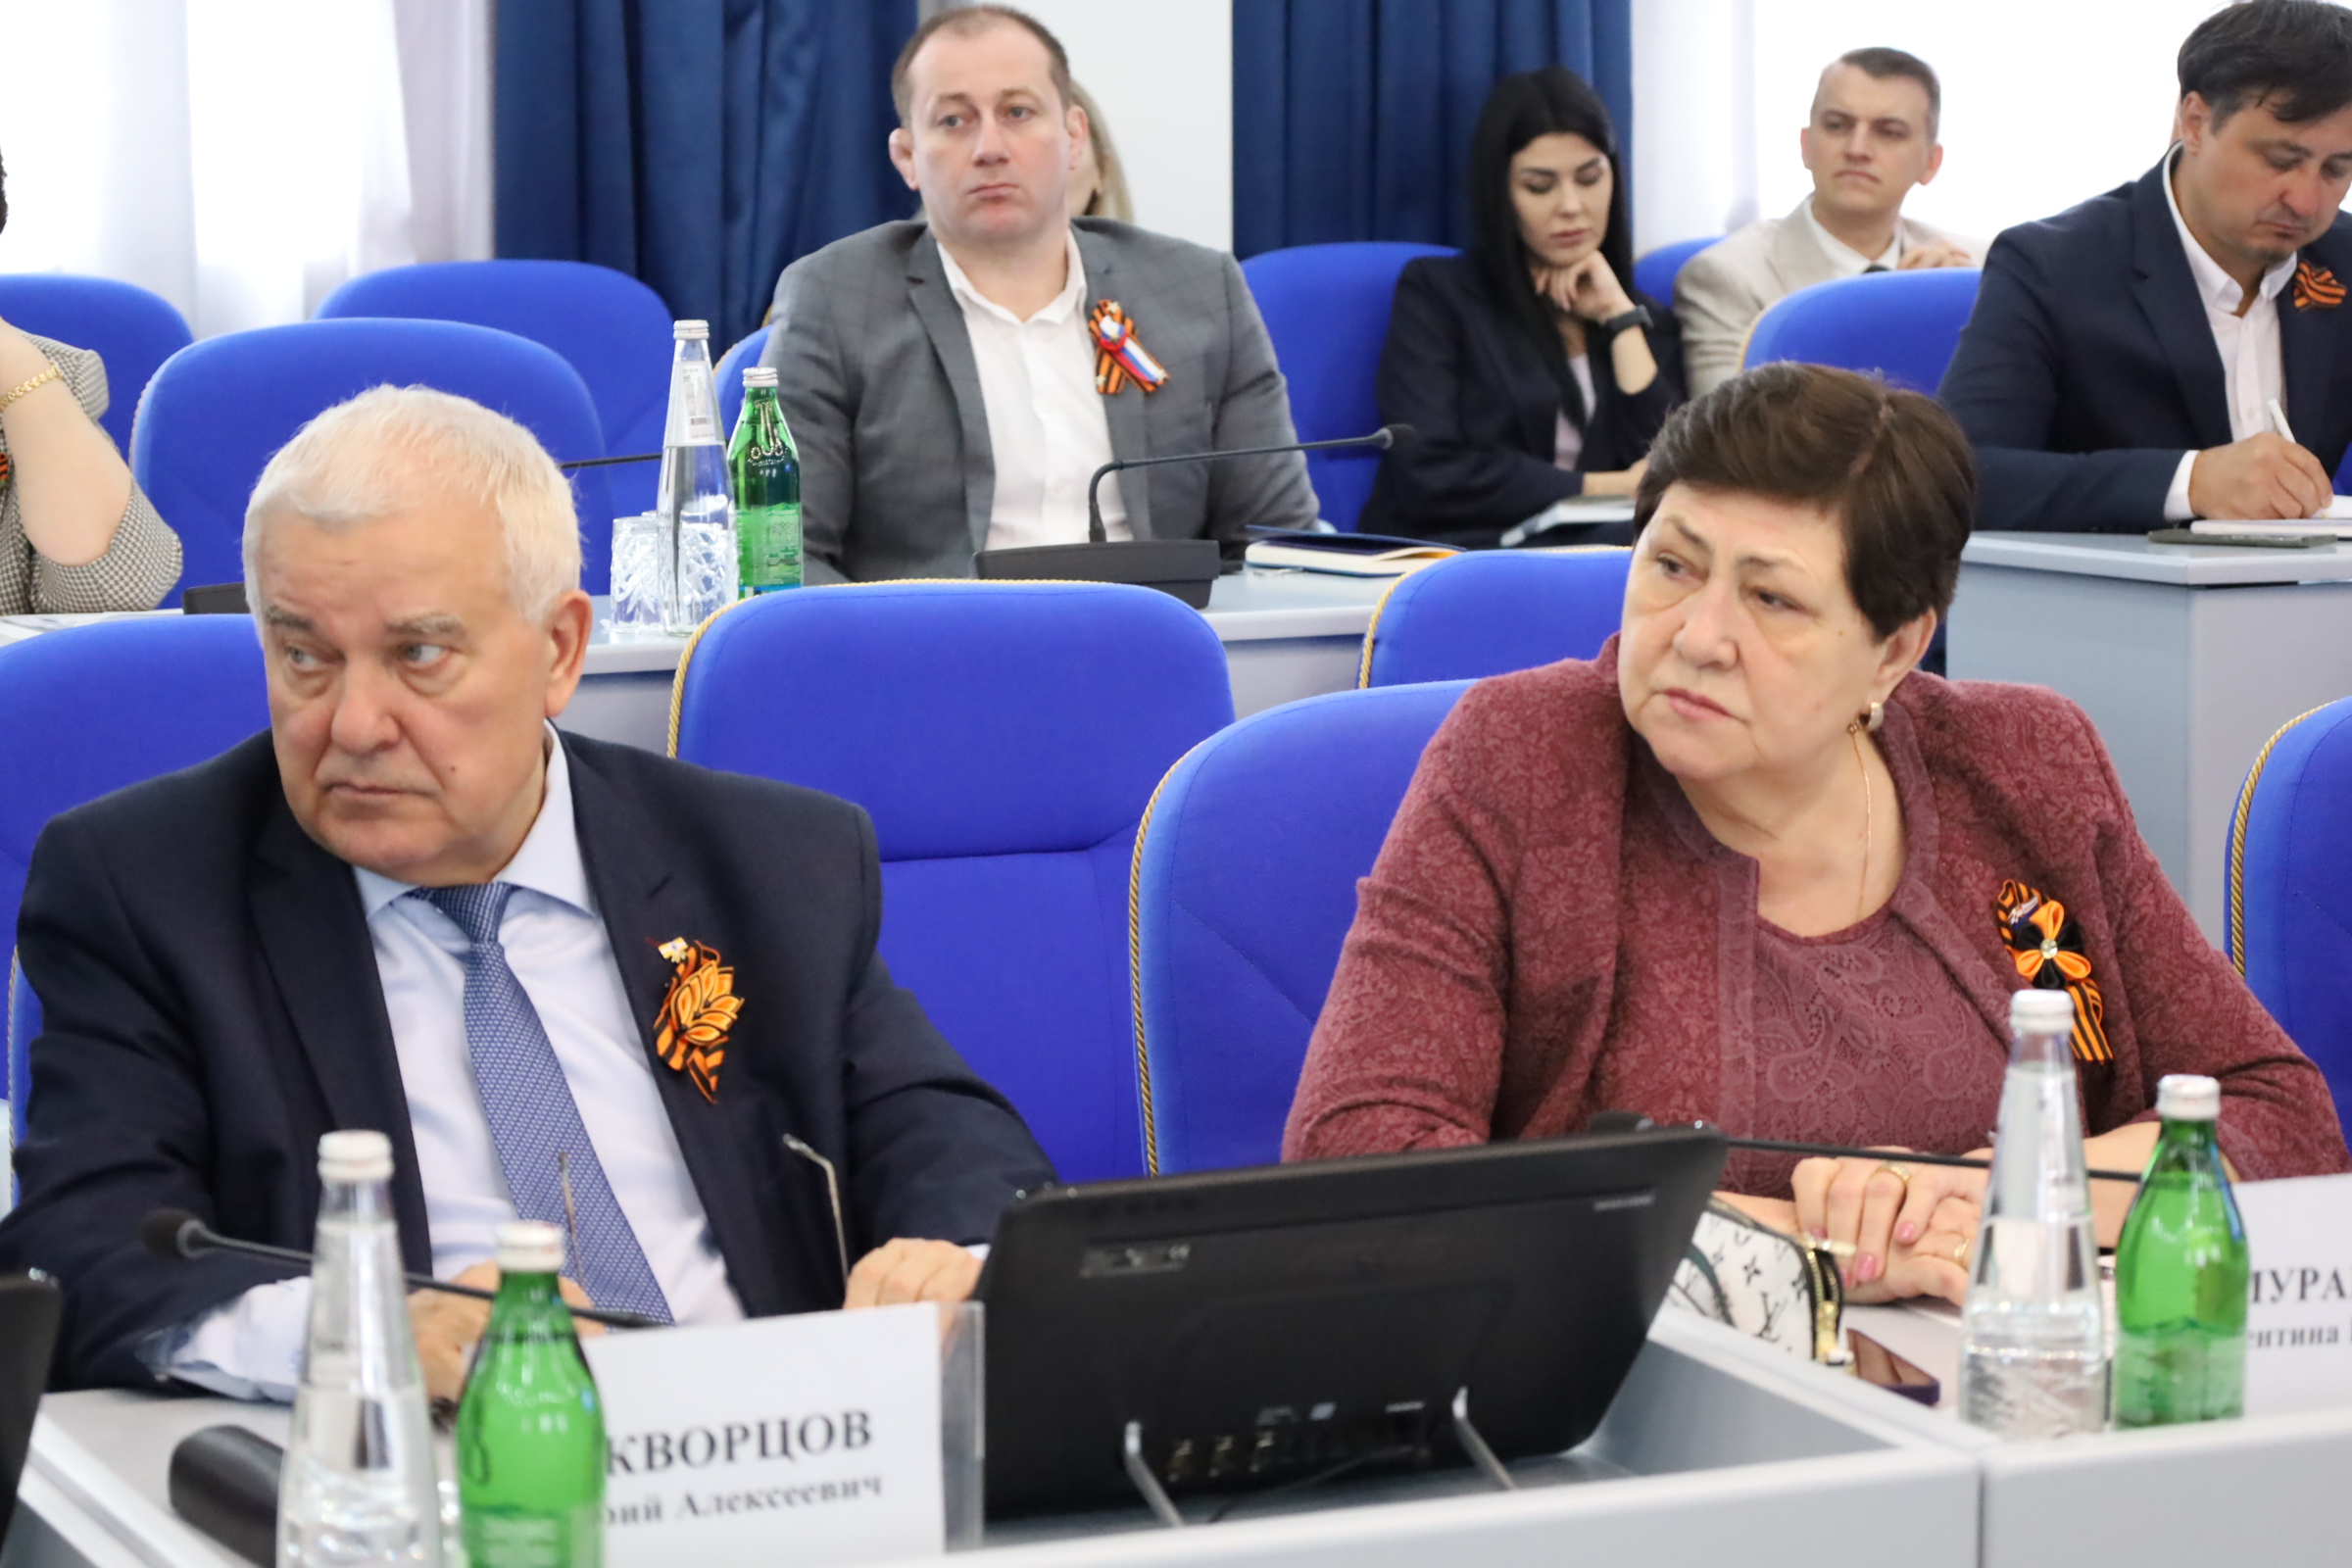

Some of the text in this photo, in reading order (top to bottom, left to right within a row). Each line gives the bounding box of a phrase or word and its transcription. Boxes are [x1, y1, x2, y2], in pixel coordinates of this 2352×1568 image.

[2251, 1265, 2352, 1303] УРА
[2249, 1325, 2339, 1349] нтина
[605, 1409, 872, 1475] КВОРЦОВ
[678, 1476, 881, 1519] Алексеевич
